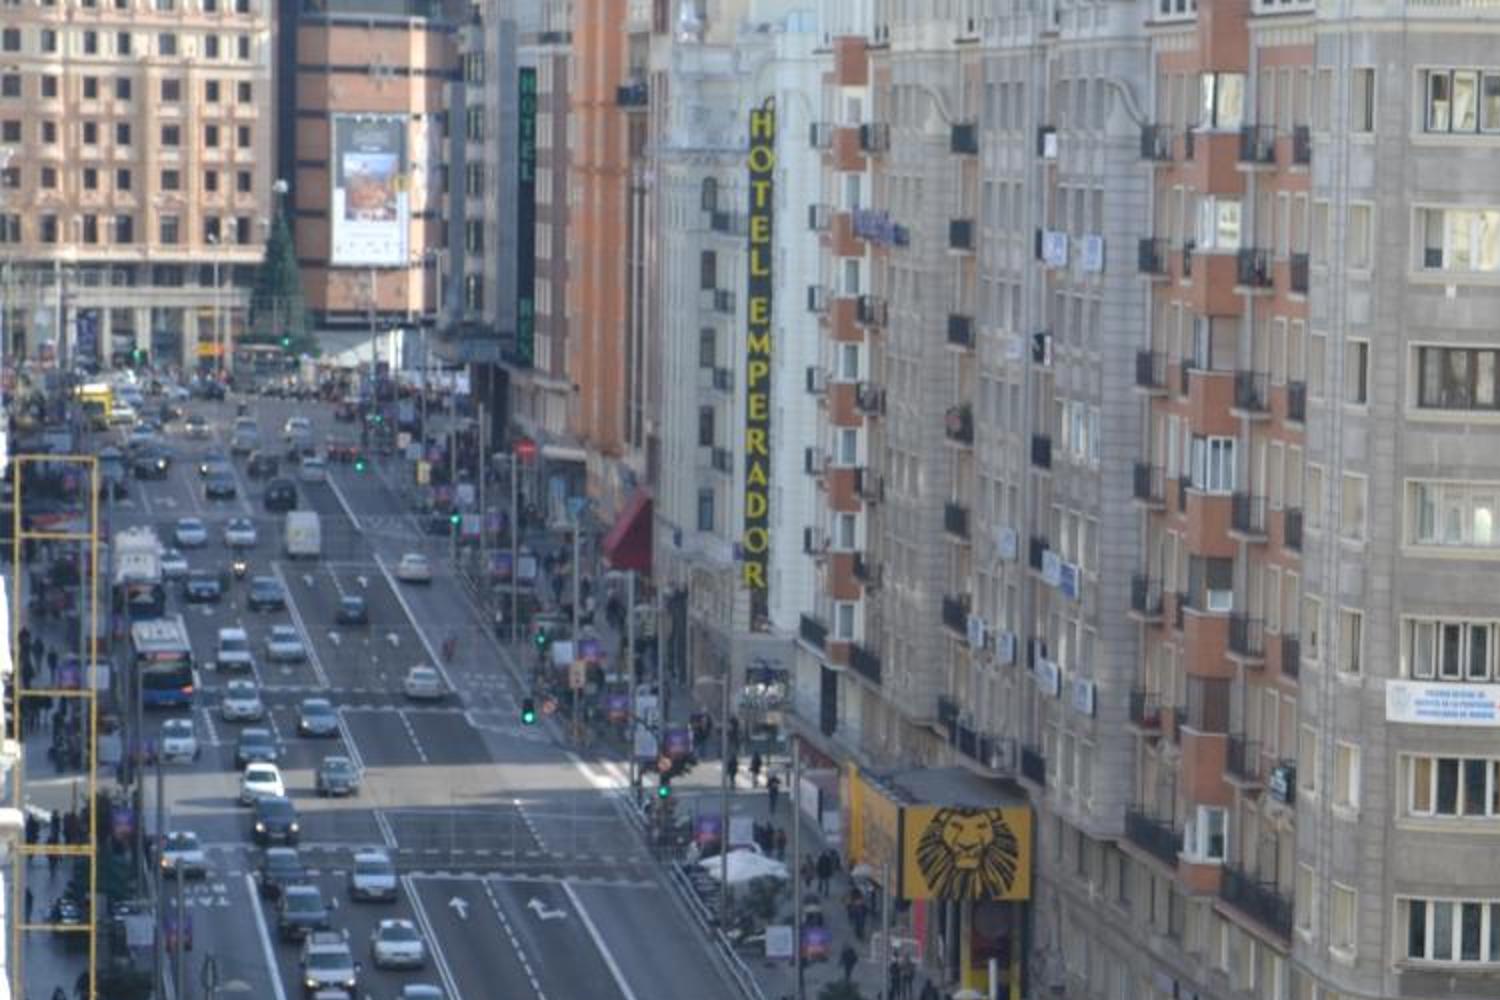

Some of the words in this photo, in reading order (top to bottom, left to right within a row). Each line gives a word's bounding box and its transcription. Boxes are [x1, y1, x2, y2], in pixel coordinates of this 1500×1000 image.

[519, 71, 535, 181] HOTEL
[750, 112, 774, 275] HOTEL
[744, 297, 770, 588] EMPERADOR
